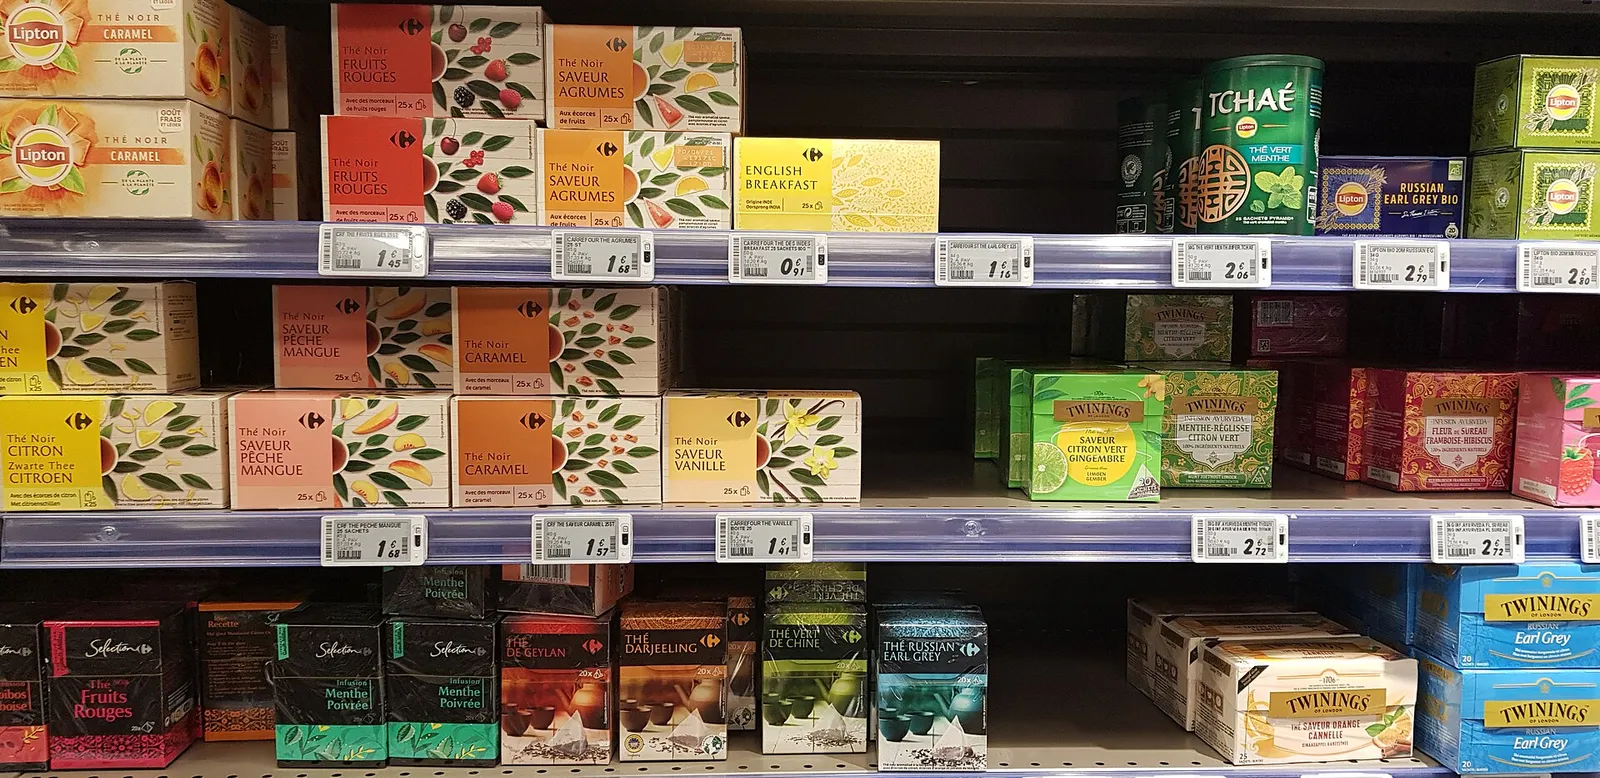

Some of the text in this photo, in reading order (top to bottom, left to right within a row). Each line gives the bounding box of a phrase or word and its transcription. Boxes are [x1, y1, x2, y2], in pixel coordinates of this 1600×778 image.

[97, 13, 120, 21] THÉ
[13, 27, 59, 44] Lipton
[103, 29, 153, 39] CARAMEL
[343, 46, 387, 55] Thé Noir
[343, 59, 387, 70] FRUITS
[558, 59, 603, 68] Thé Noir
[343, 72, 397, 83] ROUGES
[559, 72, 609, 82] SAVEUR
[559, 87, 624, 98] AGRUMES
[1209, 82, 1296, 117] TCHAÉ
[1549, 97, 1576, 108] Lipton
[104, 135, 167, 144] THÉ NOIR
[1249, 145, 1268, 153] THÉ
[20, 149, 65, 165] Lipton
[110, 151, 160, 162] CARAMEL
[332, 158, 378, 167] Thé Noir
[549, 163, 567, 171] Thé
[333, 171, 378, 182] FRUITS
[746, 166, 802, 176] ENGLISH
[549, 176, 600, 187] SAVEUR
[746, 180, 818, 190] BREAKFAST
[333, 184, 388, 195] ROUGES
[1400, 183, 1444, 193] RUSSIAN
[549, 191, 615, 202] AGRUMES
[1339, 194, 1364, 205] Lipton
[1384, 195, 1459, 205] EARL GREY BIO
[1550, 192, 1576, 202] Lipton
[377, 250, 386, 267] 1
[608, 255, 616, 272] 1
[618, 265, 630, 273] 68
[781, 258, 793, 275] 0
[793, 268, 804, 276] 91
[989, 261, 997, 277] 1
[1225, 262, 1236, 279] 2
[1405, 265, 1415, 281] 2
[1568, 268, 1578, 284] 2
[283, 324, 329, 334] SAVEUR
[283, 334, 322, 345] PÊCHE
[465, 340, 509, 348] Thé Noir
[283, 347, 340, 357] MANGUE
[465, 352, 527, 363] CARAMEL
[1066, 402, 1131, 419] TWININGS
[1185, 398, 1246, 414] TWININGS
[1436, 400, 1490, 414] TWININGS
[262, 428, 286, 436] Noir
[1178, 422, 1250, 432] MENTHE-RÉGLISSE
[1432, 427, 1452, 435] FLEUR
[1461, 427, 1488, 435] SUREAU
[7, 435, 55, 443] Thé Noir
[675, 437, 718, 446] Thé Noir
[1079, 436, 1115, 444] SAVEUR
[1188, 434, 1240, 442] CITRON VERT
[1426, 436, 1492, 445] FRAMBOISE-HIBISCUS
[240, 440, 291, 450] SAVEUR
[1067, 446, 1128, 454] CITRON VERT
[8, 446, 63, 457] CITRON
[241, 450, 283, 463] PÊCHE
[464, 452, 510, 461] Thé Noir
[675, 449, 723, 460] SAVEUR
[1069, 454, 1125, 463] GINGEMBRE
[8, 462, 75, 470] Zwarte Thee
[241, 465, 303, 475] MANGUE
[465, 464, 529, 475] CARAMEL
[675, 461, 726, 471] VANILLE
[9, 473, 73, 484] CITROEN
[377, 540, 386, 557] 1
[388, 550, 400, 558] 68
[587, 539, 595, 555] 1
[596, 548, 609, 556] 57
[768, 538, 777, 554] 1
[1243, 539, 1254, 555] 2
[1482, 540, 1491, 555] 2
[1493, 548, 1503, 556] 72
[423, 577, 464, 587] Menthe
[425, 588, 464, 599] Poivrée
[1501, 596, 1591, 617] TWININGS
[625, 633, 649, 644] THÉ
[769, 628, 818, 639] THÉ VERT
[1515, 632, 1571, 646] Earl Grey
[769, 639, 820, 648] DE CHINE
[883, 640, 955, 652] THÉ RUSSIAN
[506, 648, 521, 657] DE
[625, 644, 697, 656] DARJEELING
[884, 652, 941, 661] EARL GREY
[325, 689, 368, 699] Menthe
[438, 686, 481, 696] Menthe
[81, 690, 128, 704] Fruits
[327, 700, 369, 710] Poivrée
[440, 698, 481, 709] Poivrée
[1286, 692, 1369, 714] TWININGS
[74, 705, 133, 722] Rouges
[1500, 702, 1588, 723] TWININGS
[1303, 721, 1331, 731] SAVEUR
[1332, 719, 1360, 729] ORANGE
[1308, 731, 1343, 740] CANNELLE
[1514, 737, 1568, 751] Earl Grey
